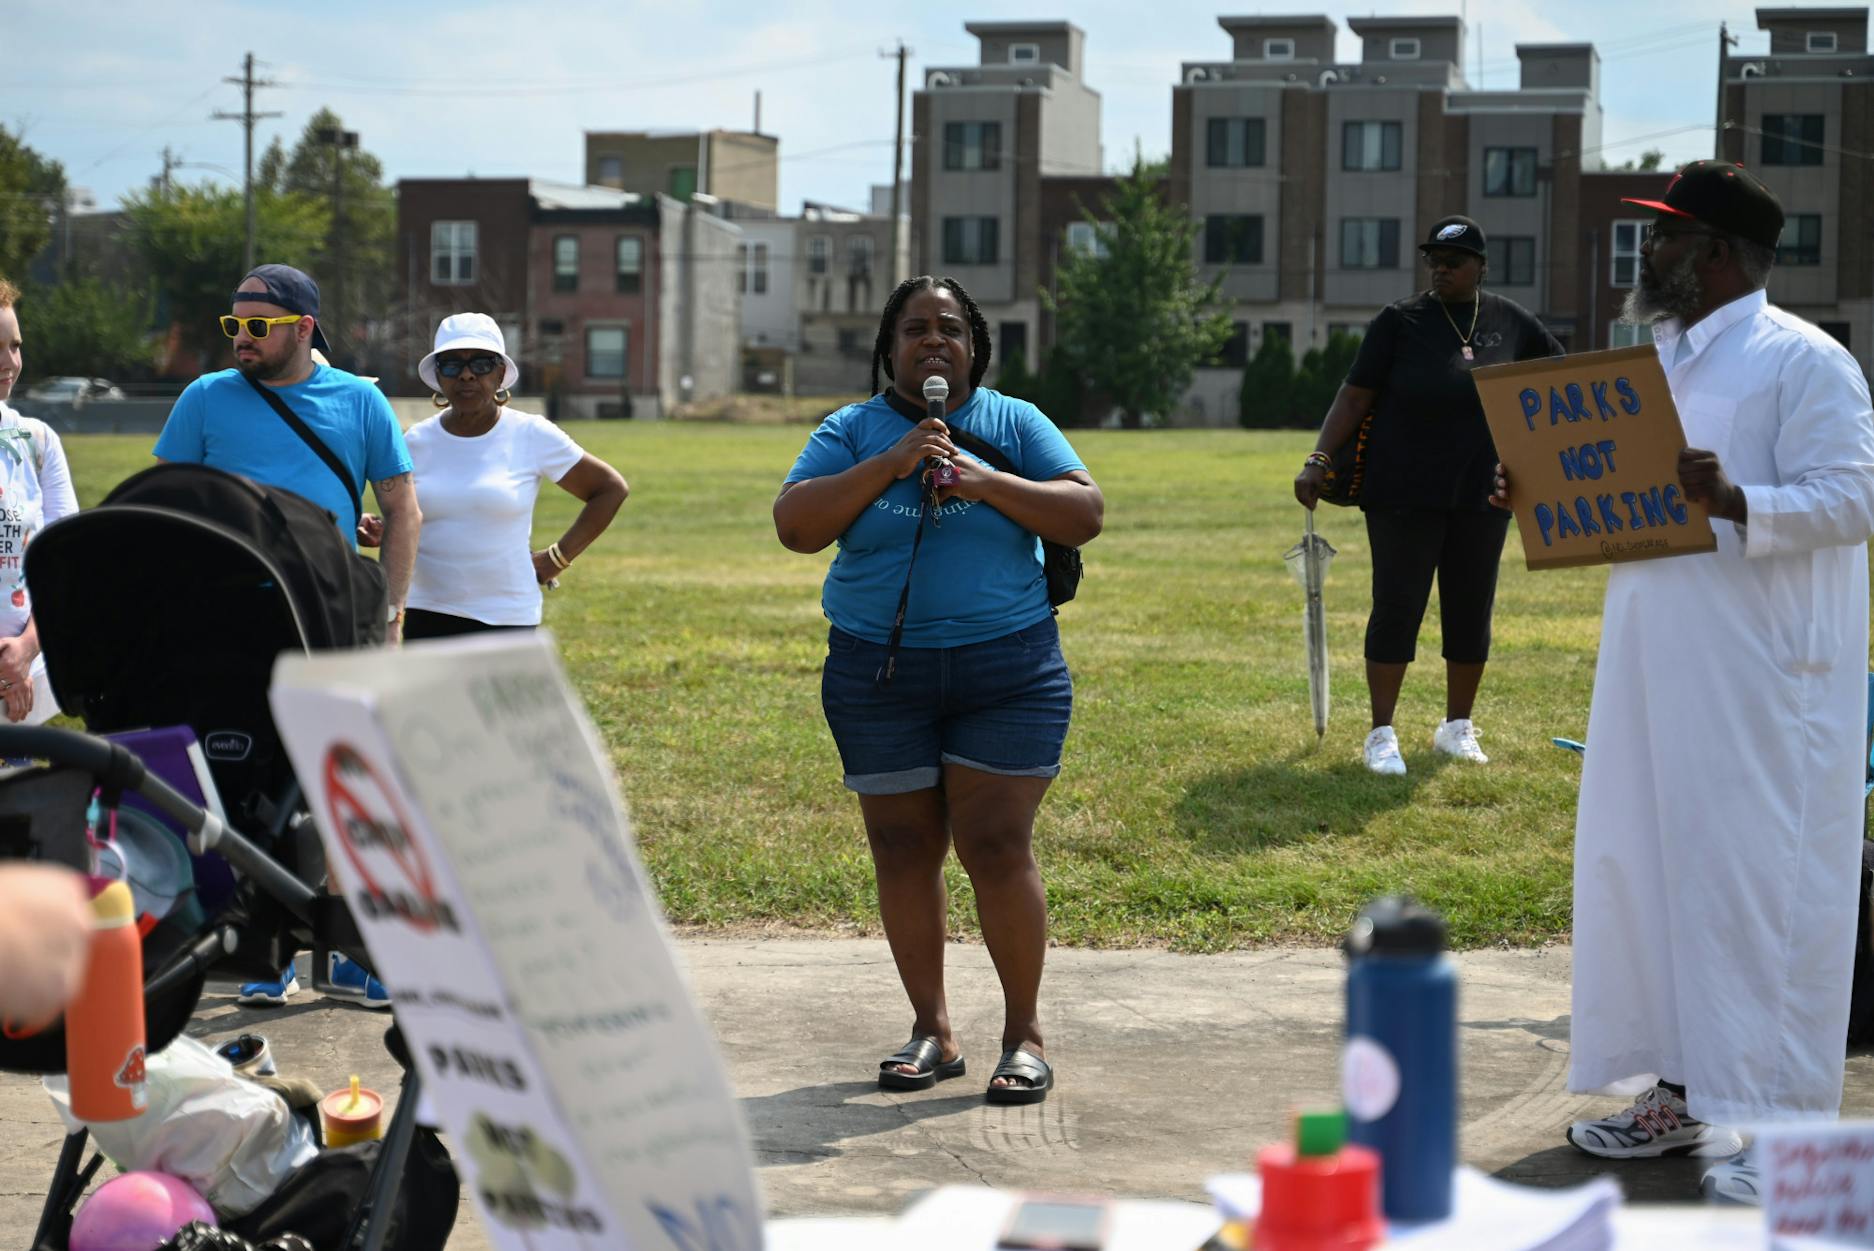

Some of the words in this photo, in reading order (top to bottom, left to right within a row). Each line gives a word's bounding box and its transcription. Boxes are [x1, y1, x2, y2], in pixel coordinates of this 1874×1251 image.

[1519, 376, 1642, 431] PARKS
[1558, 439, 1617, 482] NOT
[1534, 483, 1689, 547] PARKING
